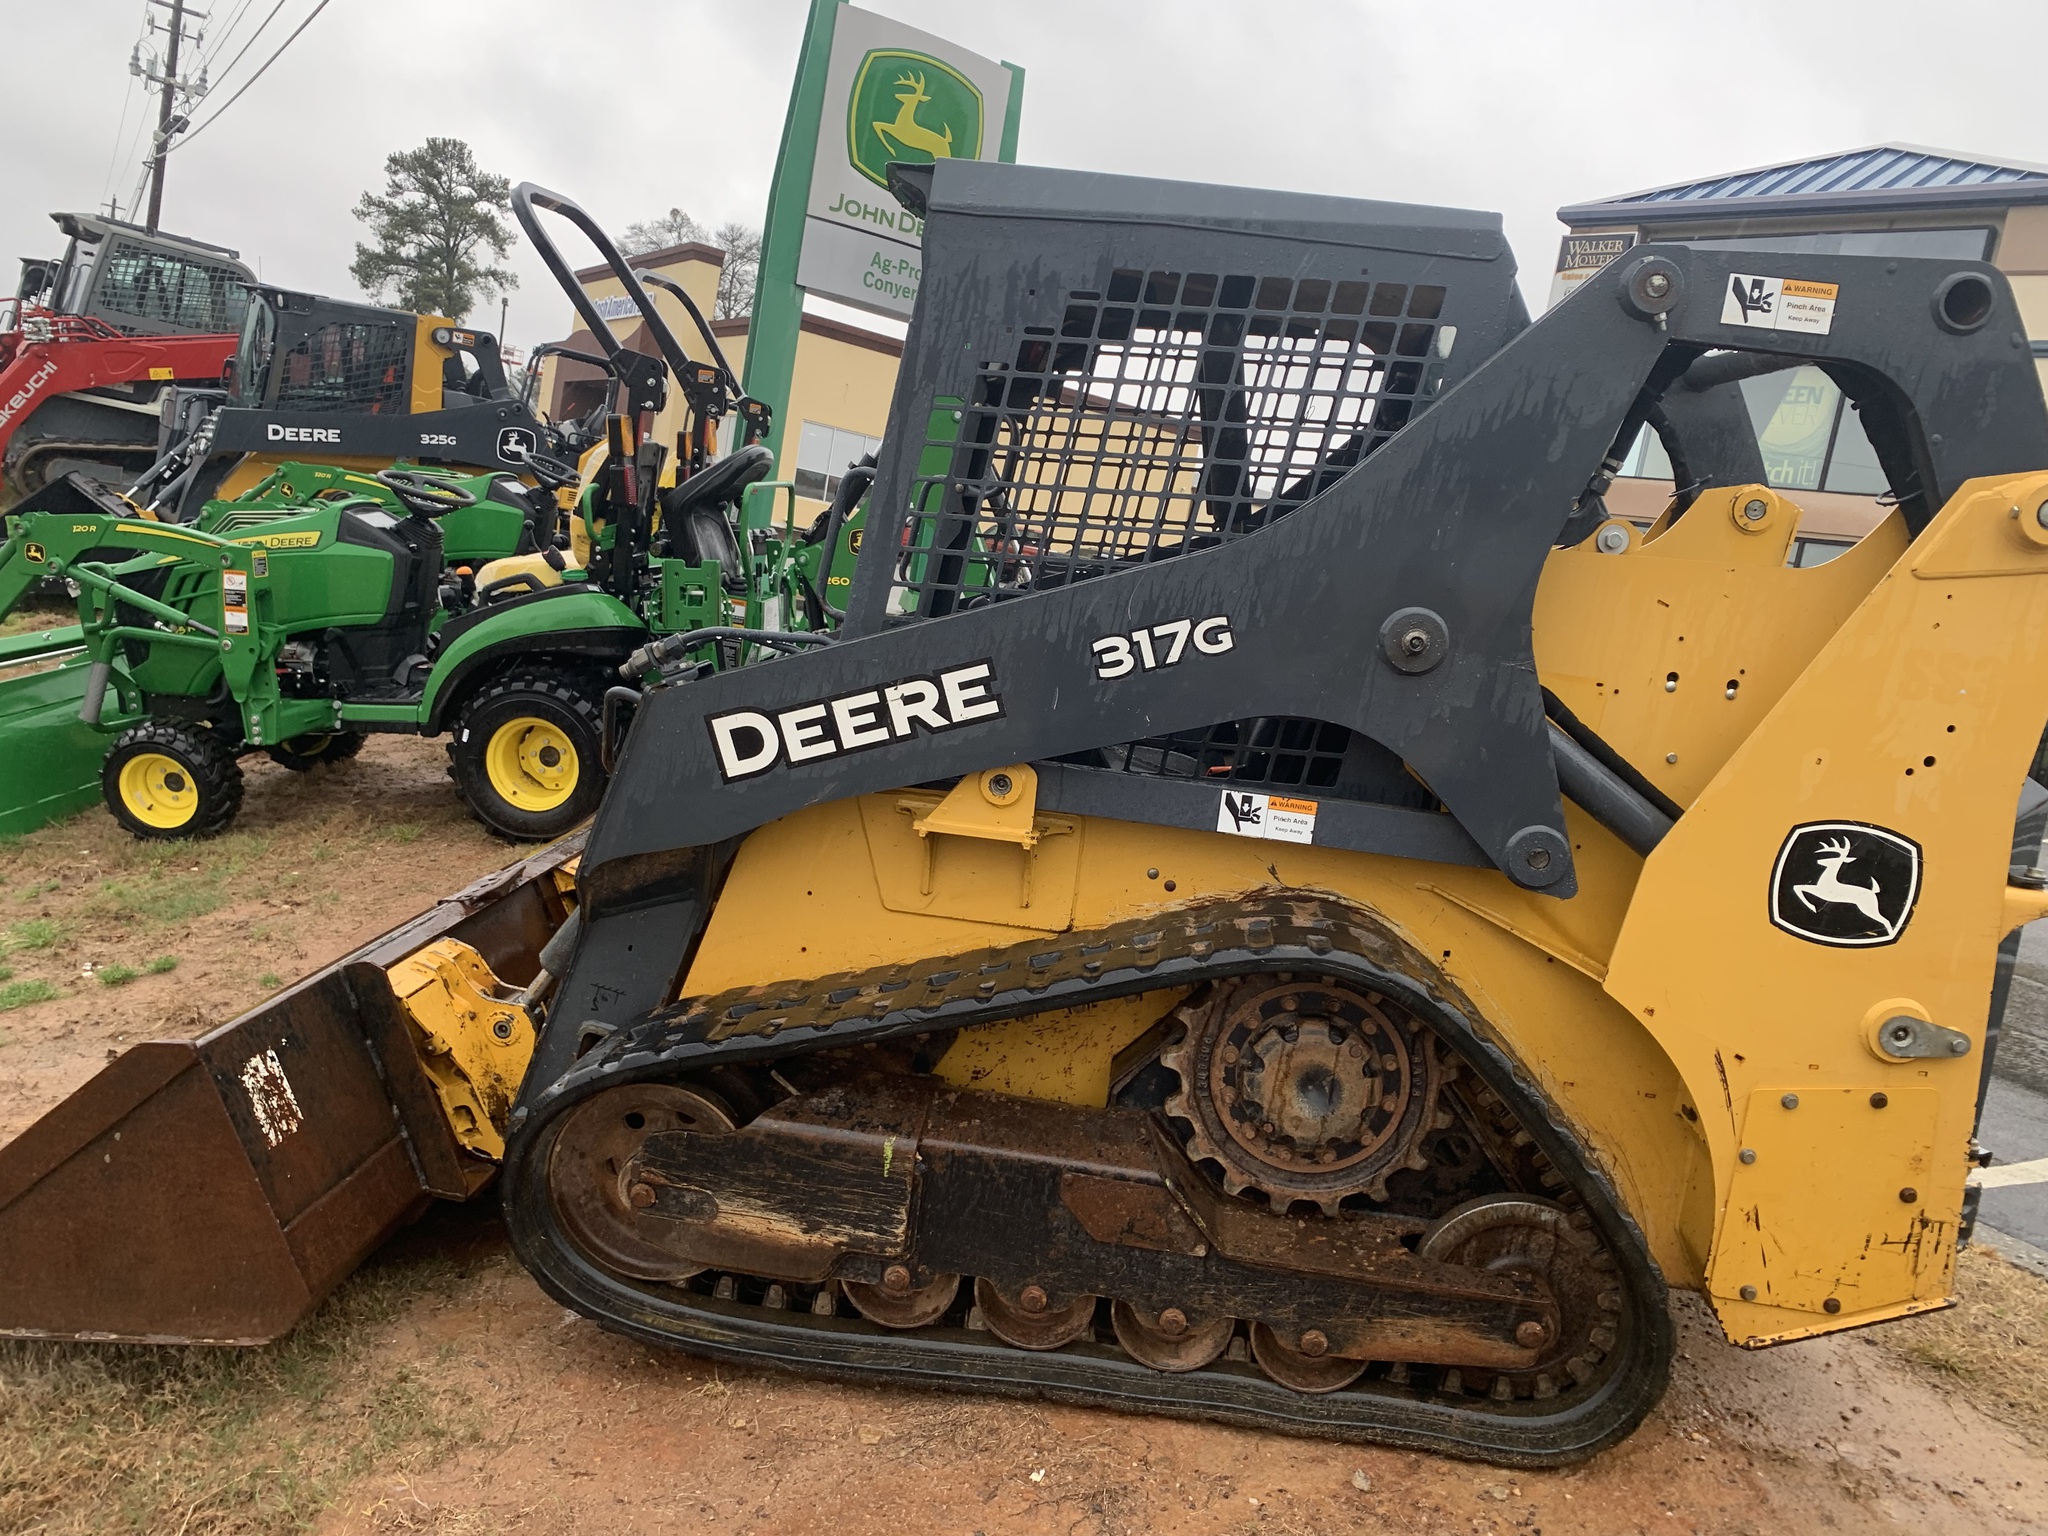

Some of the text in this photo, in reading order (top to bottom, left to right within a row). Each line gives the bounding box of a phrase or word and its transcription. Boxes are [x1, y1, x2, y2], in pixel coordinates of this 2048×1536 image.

[829, 193, 895, 229] JOHN
[1568, 239, 1624, 255] WALKER
[1794, 285, 1833, 296] WARNING
[1787, 302, 1826, 312] Pinch Area
[1788, 314, 1820, 325] Keep Away
[267, 423, 341, 443] DEERE
[420, 434, 457, 446] 325G
[270, 536, 312, 548] DEERE
[1091, 616, 1235, 679] 317G
[711, 663, 999, 779] DEERE
[1278, 800, 1313, 812] WARNING
[1273, 815, 1291, 823] Pinch
[1289, 828, 1303, 836] Away
